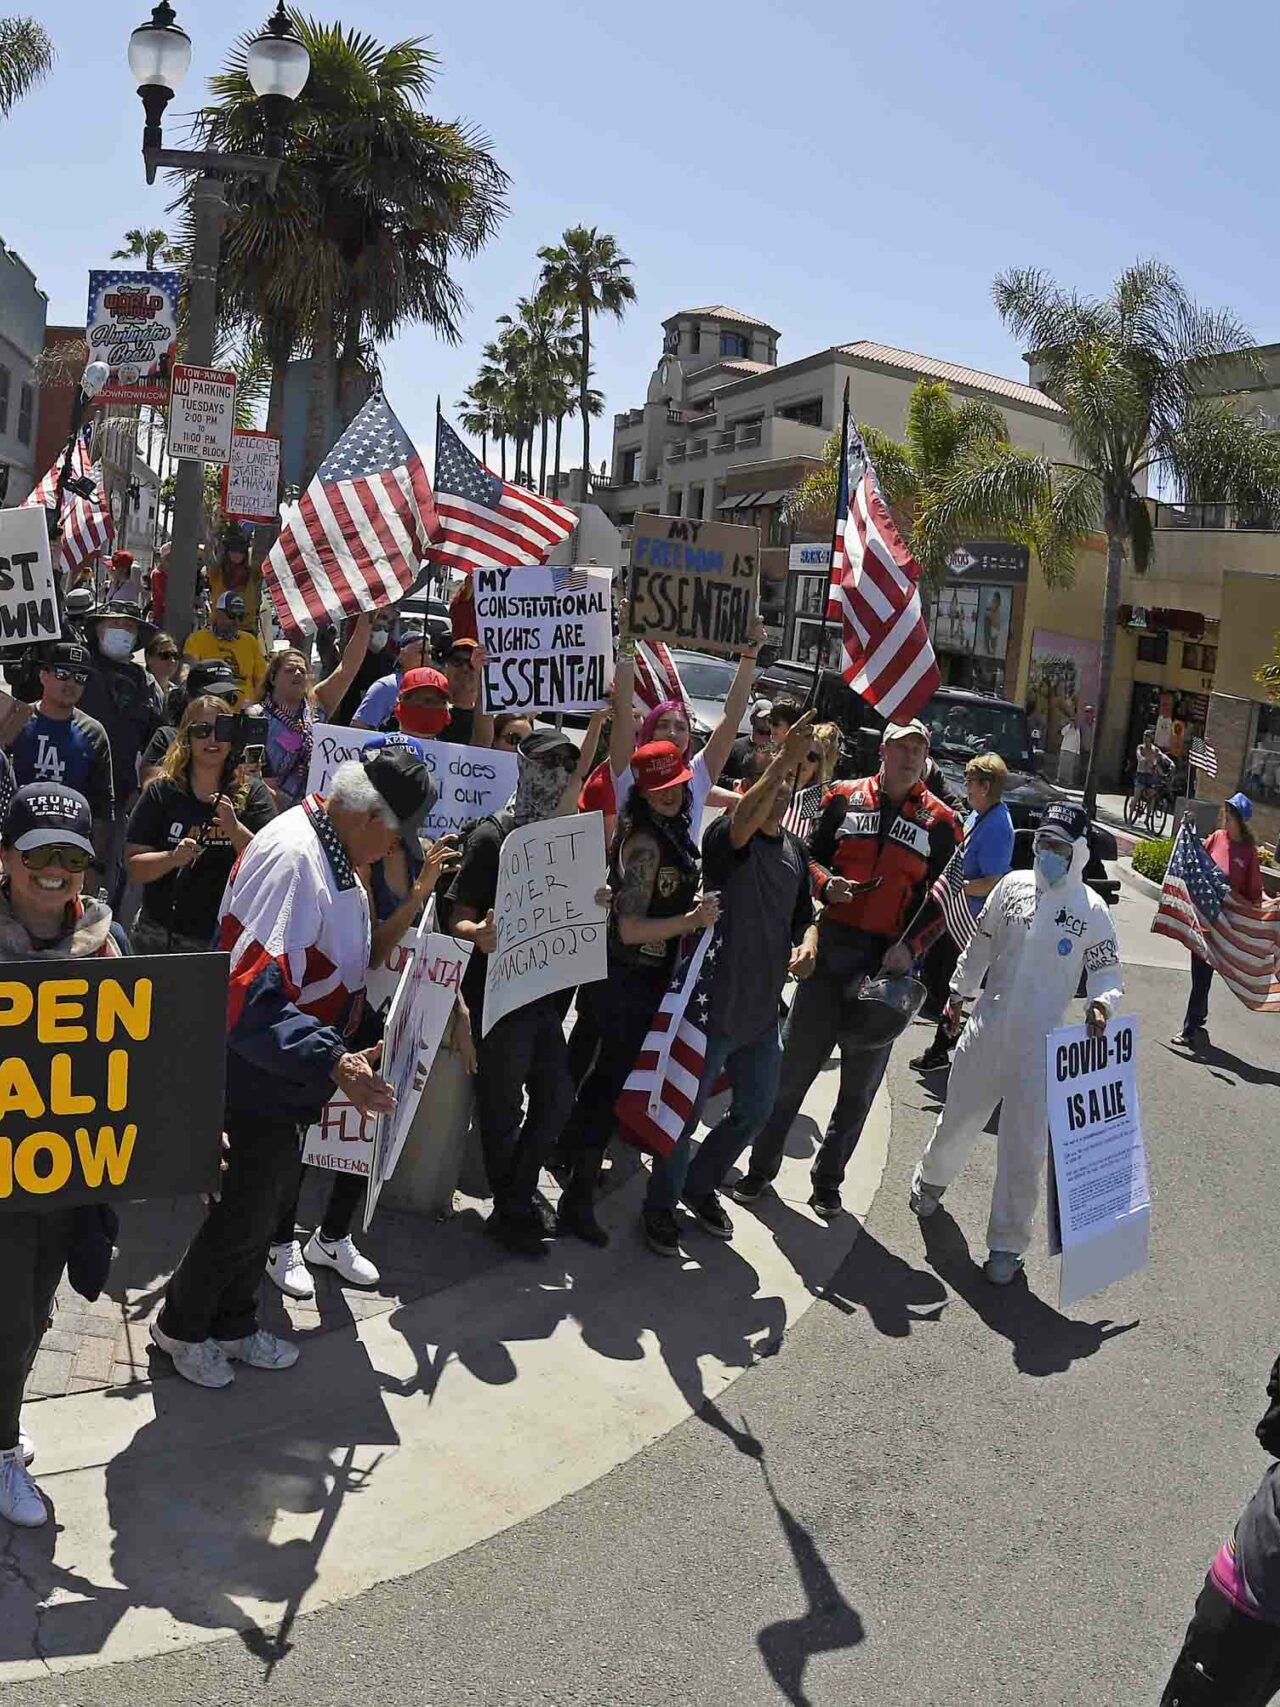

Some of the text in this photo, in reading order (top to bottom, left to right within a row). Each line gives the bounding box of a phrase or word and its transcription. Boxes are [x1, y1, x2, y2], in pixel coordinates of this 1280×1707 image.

[103, 293, 164, 310] WORLD
[91, 321, 172, 350] Huntington
[107, 342, 156, 366] Beach
[183, 367, 227, 382] TOW-AWAY
[174, 377, 231, 398] NO PARKING
[181, 398, 225, 415] TUESDAYS
[173, 442, 199, 454] ENTIRE
[202, 446, 226, 458] BLOCK
[668, 520, 703, 543] MY
[732, 554, 755, 578] IS
[478, 568, 511, 593] MY
[484, 623, 586, 653] RIGHTS ARE
[384, 735, 409, 745] KEEP
[33, 734, 66, 782] LA
[449, 757, 497, 780] does
[26, 795, 83, 810] TRUMP
[455, 787, 493, 806] our
[31, 804, 80, 817] PENCE
[889, 818, 917, 845] AHA
[497, 900, 583, 953] PEOPLE
[1084, 939, 1116, 961] INFO
[1056, 1027, 1133, 1083] COVID-19
[1067, 1080, 1126, 1131] IS A LIE
